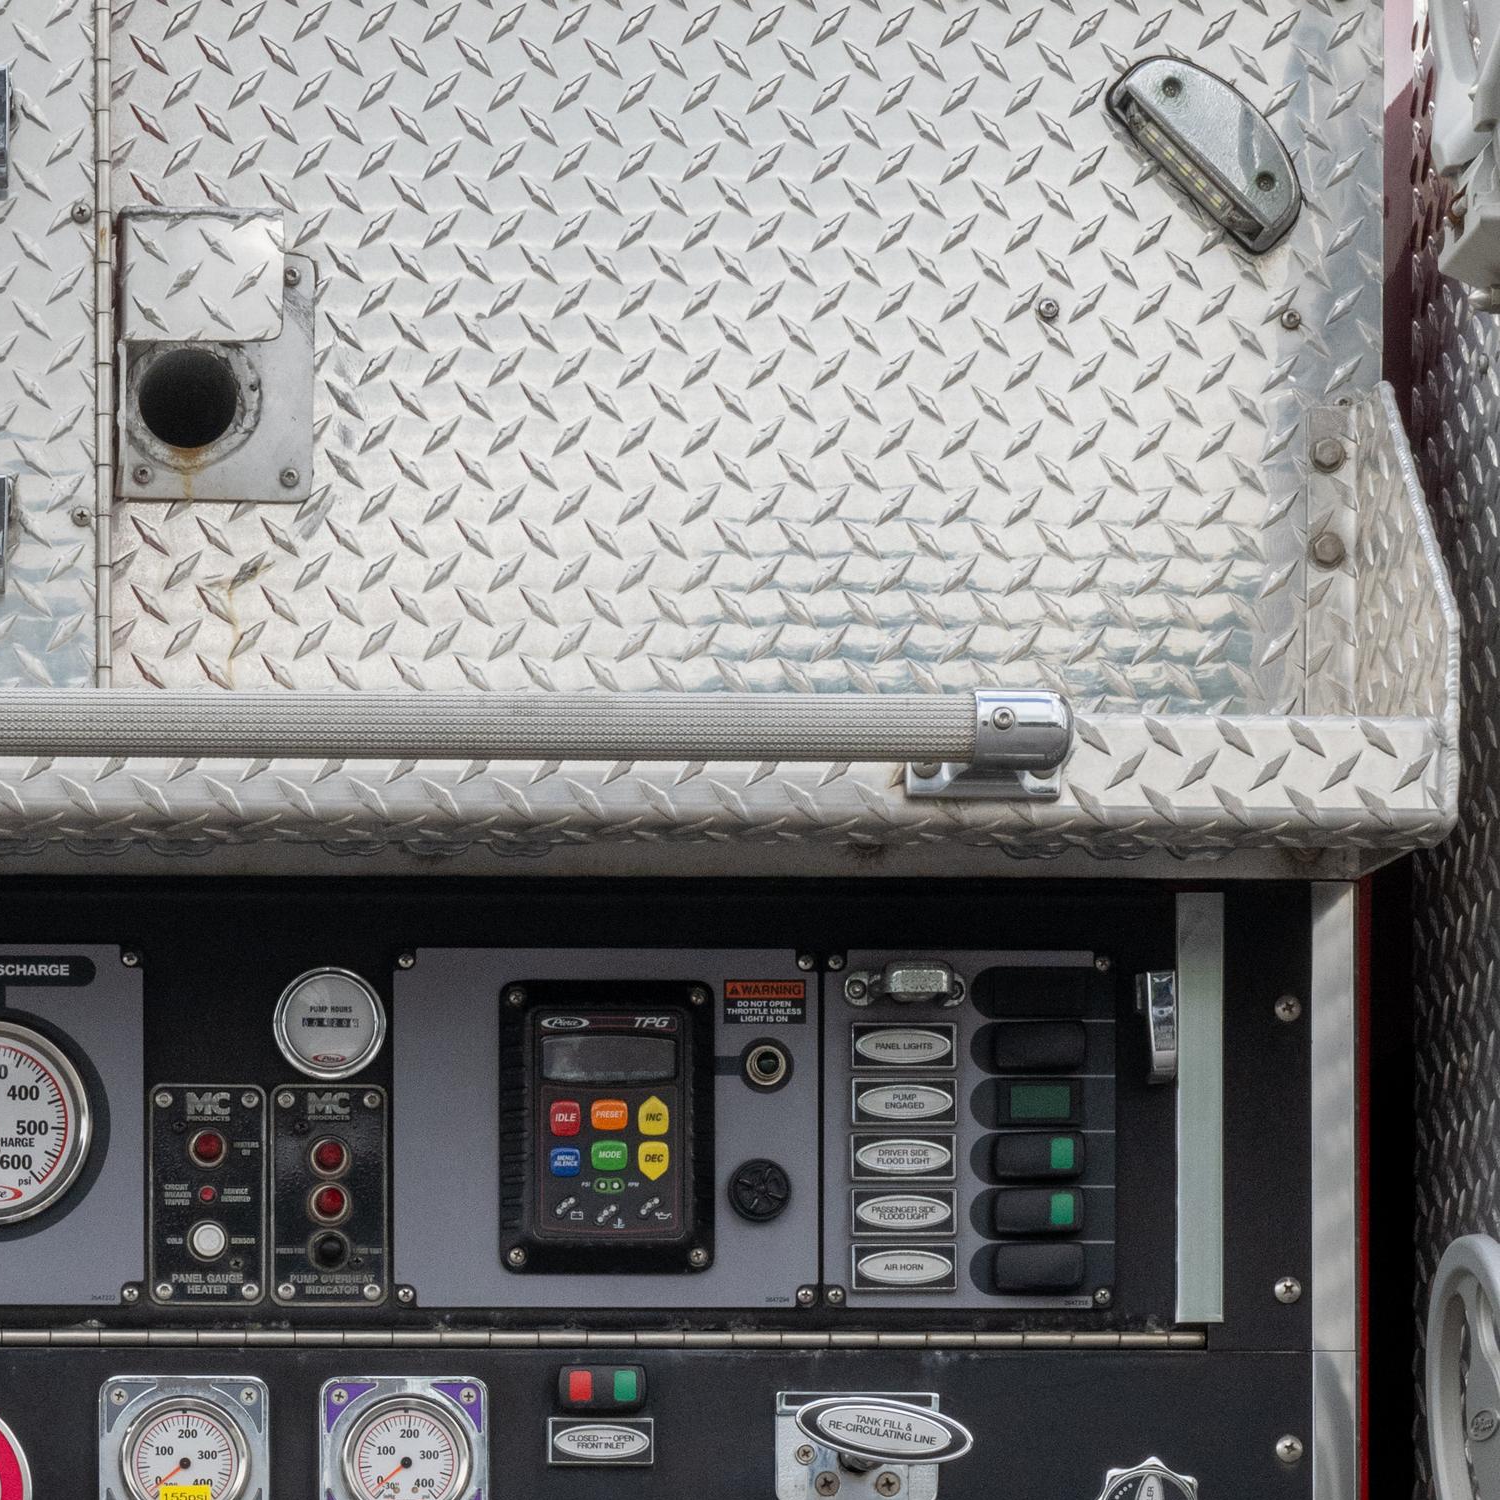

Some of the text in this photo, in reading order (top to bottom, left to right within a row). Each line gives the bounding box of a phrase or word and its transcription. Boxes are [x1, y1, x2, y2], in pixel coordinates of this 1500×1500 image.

[741, 985, 801, 995] WARNING
[633, 1017, 669, 1028] TPG
[555, 1110, 661, 1122] IDLE PRESET INC
[598, 1151, 663, 1162] MODE DEC
[172, 1274, 243, 1283] PANEL GAUGE
[188, 1285, 227, 1294] HEATER
[855, 1414, 912, 1431] TANK FILL &
[829, 1420, 936, 1446] RE-CIRCULATING LINE
